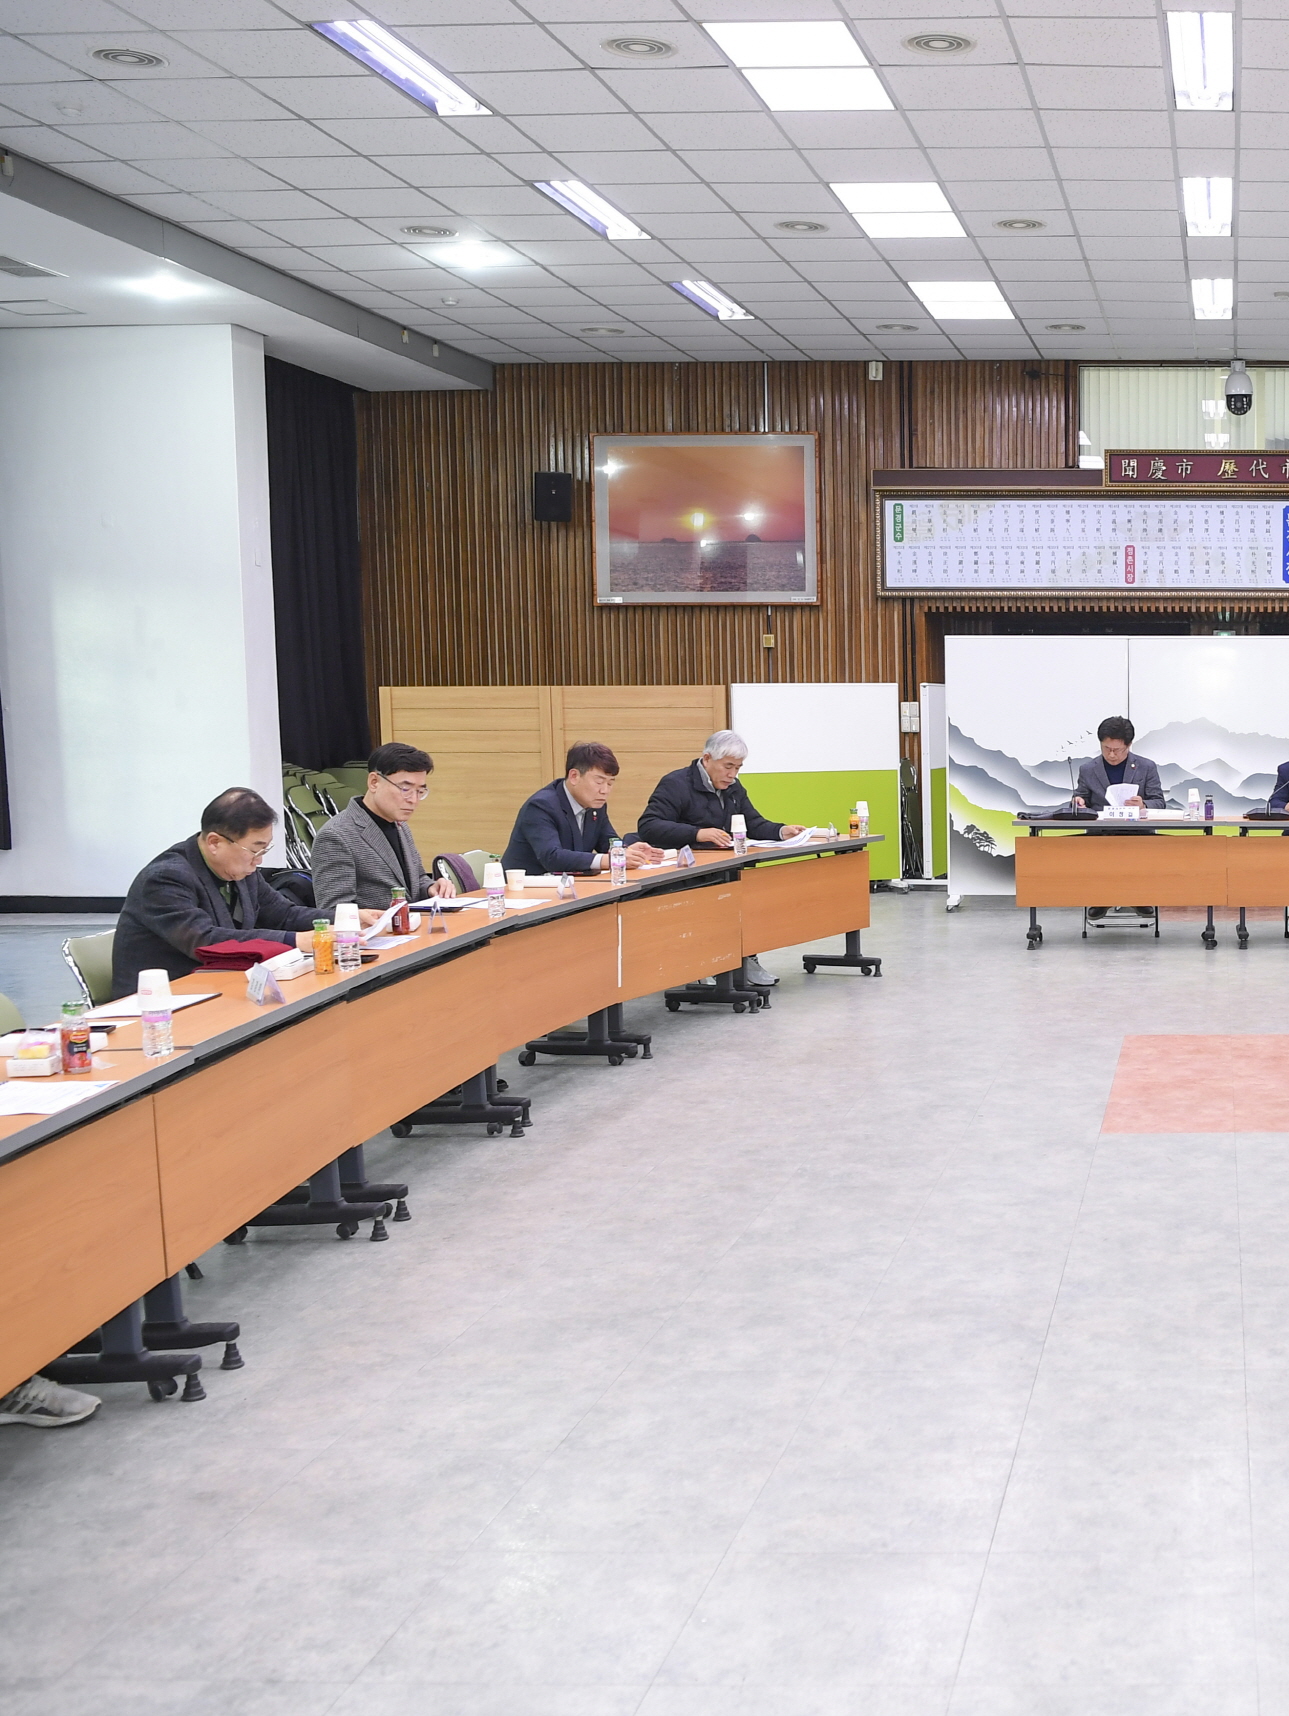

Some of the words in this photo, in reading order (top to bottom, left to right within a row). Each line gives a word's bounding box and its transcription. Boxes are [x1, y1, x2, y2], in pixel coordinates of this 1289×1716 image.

[1120, 458, 1194, 480] 聞慶市
[894, 505, 903, 541] 문경군수
